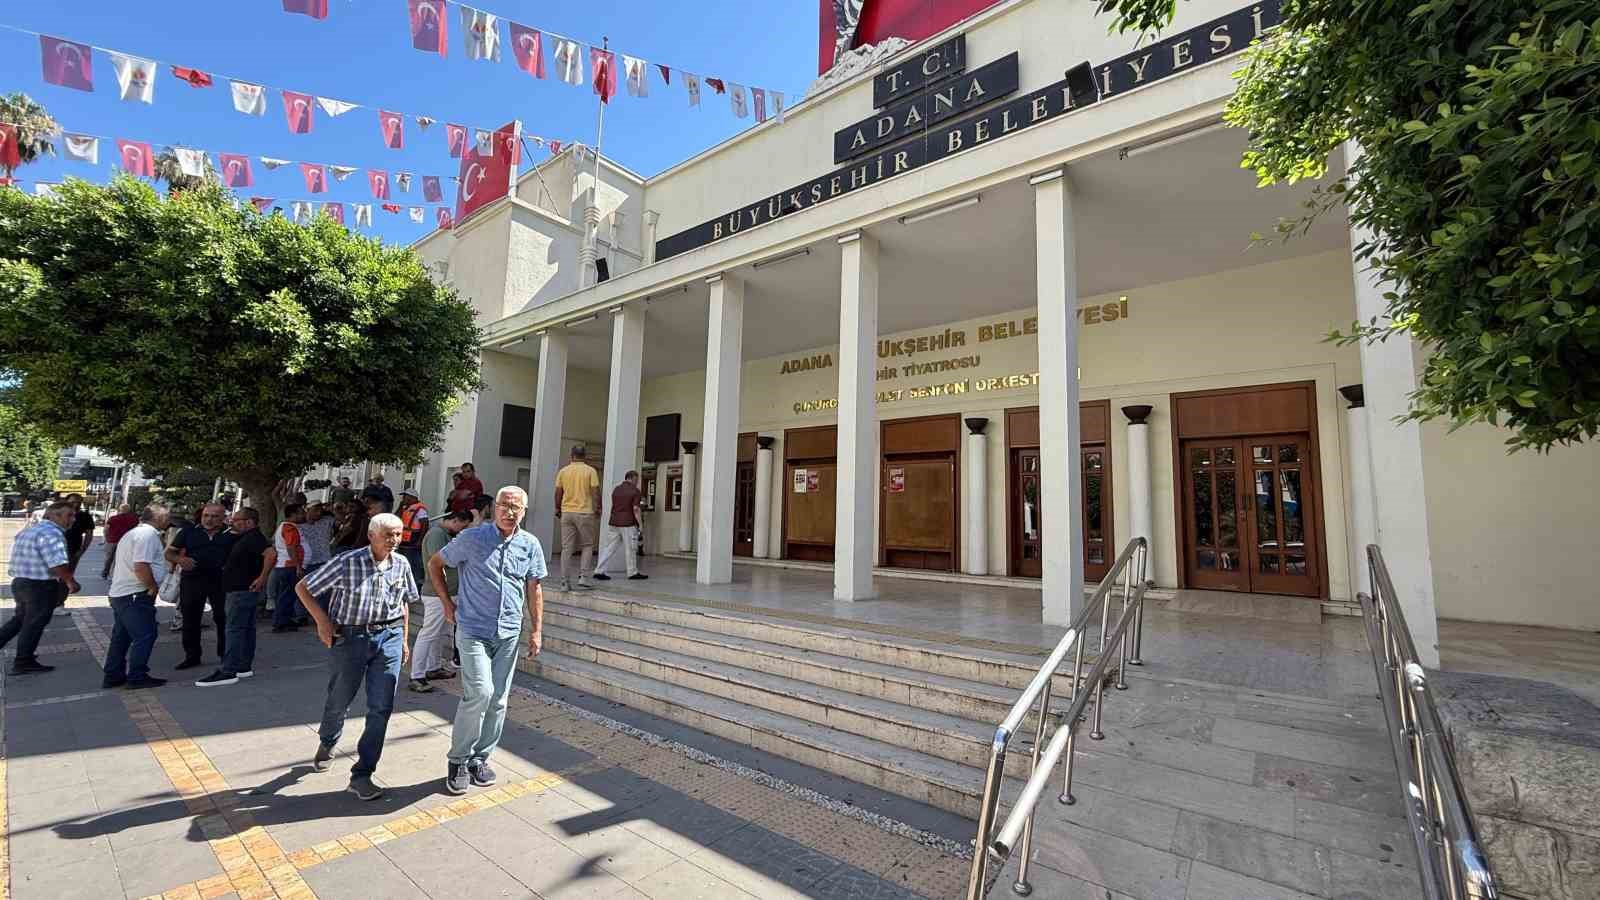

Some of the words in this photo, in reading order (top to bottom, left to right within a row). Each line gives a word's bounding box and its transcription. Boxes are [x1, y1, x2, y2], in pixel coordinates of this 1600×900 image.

[886, 70, 910, 94] T.
[851, 77, 985, 149] ADANA
[780, 353, 833, 375] ADANA
[877, 328, 965, 358] ÜKŞEHİR
[978, 296, 1128, 343] BELEESİ
[876, 366, 897, 381] HİR
[902, 354, 981, 377] TİYATROSU
[793, 399, 839, 415] ÇUKURO
